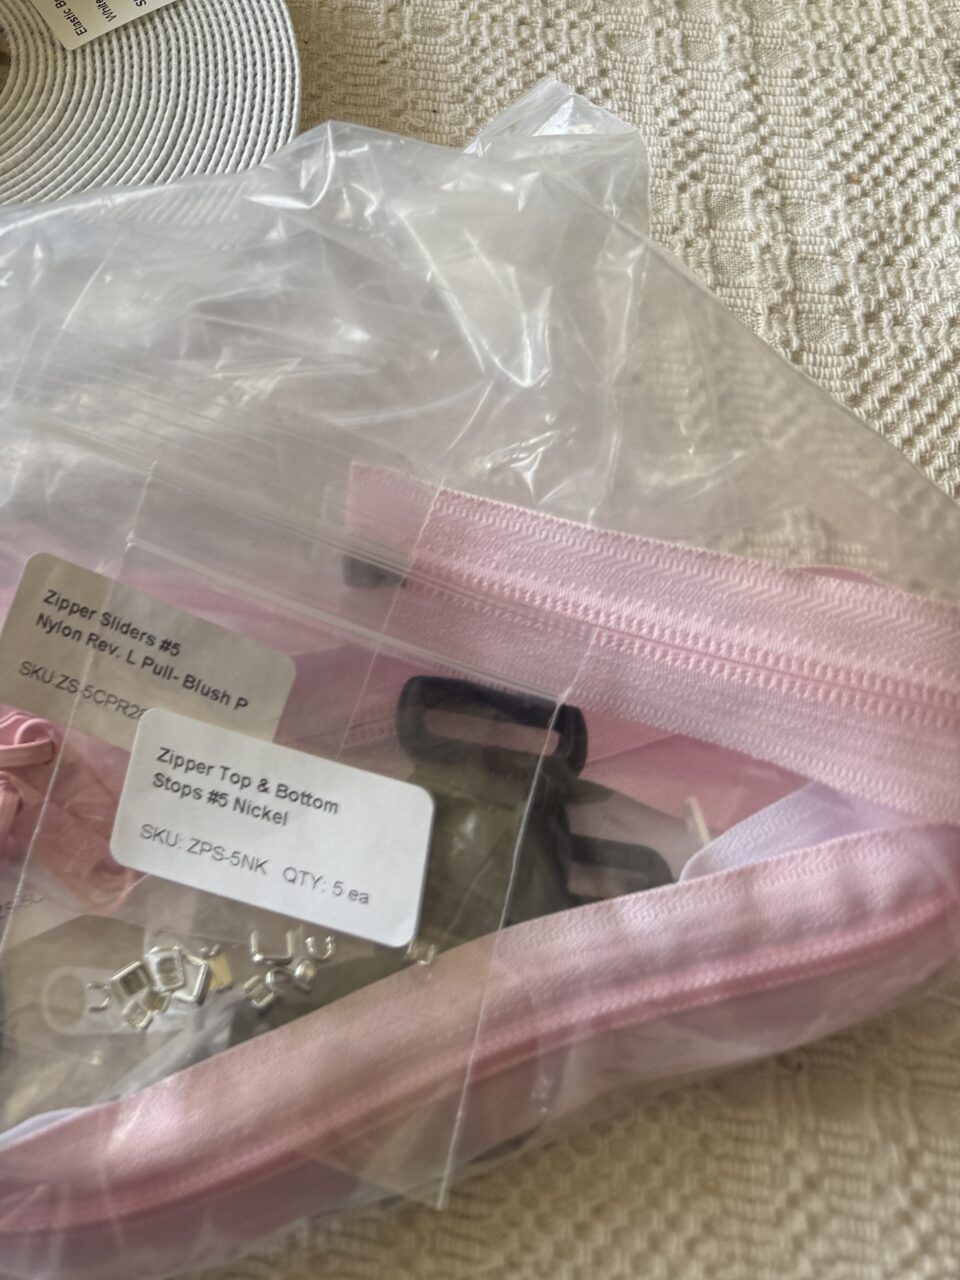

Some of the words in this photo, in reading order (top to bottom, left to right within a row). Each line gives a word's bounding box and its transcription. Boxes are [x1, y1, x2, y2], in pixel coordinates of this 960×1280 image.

[63, 7, 88, 37] Elastic
[43, 589, 97, 621] Zipper
[100, 611, 157, 647] Sliders
[158, 637, 182, 657] #5
[36, 613, 83, 641] Nylon
[85, 632, 121, 658] Rev.
[126, 649, 136, 665] L
[141, 656, 179, 681] Pull-
[182, 674, 231, 706] Blush
[234, 696, 249, 711] P
[152, 772, 203, 800] Stops
[206, 789, 228, 807] #5
[232, 796, 289, 826] Nickel
[156, 746, 215, 777] Zipper
[219, 765, 252, 791] Top
[256, 778, 270, 793] &
[275, 783, 340, 815] Bottom
[140, 823, 182, 850] SKU:
[187, 837, 269, 875] ZPS-5NK
[283, 867, 326, 893] QTY:
[333, 880, 345, 897] 5
[348, 888, 370, 904] ea
